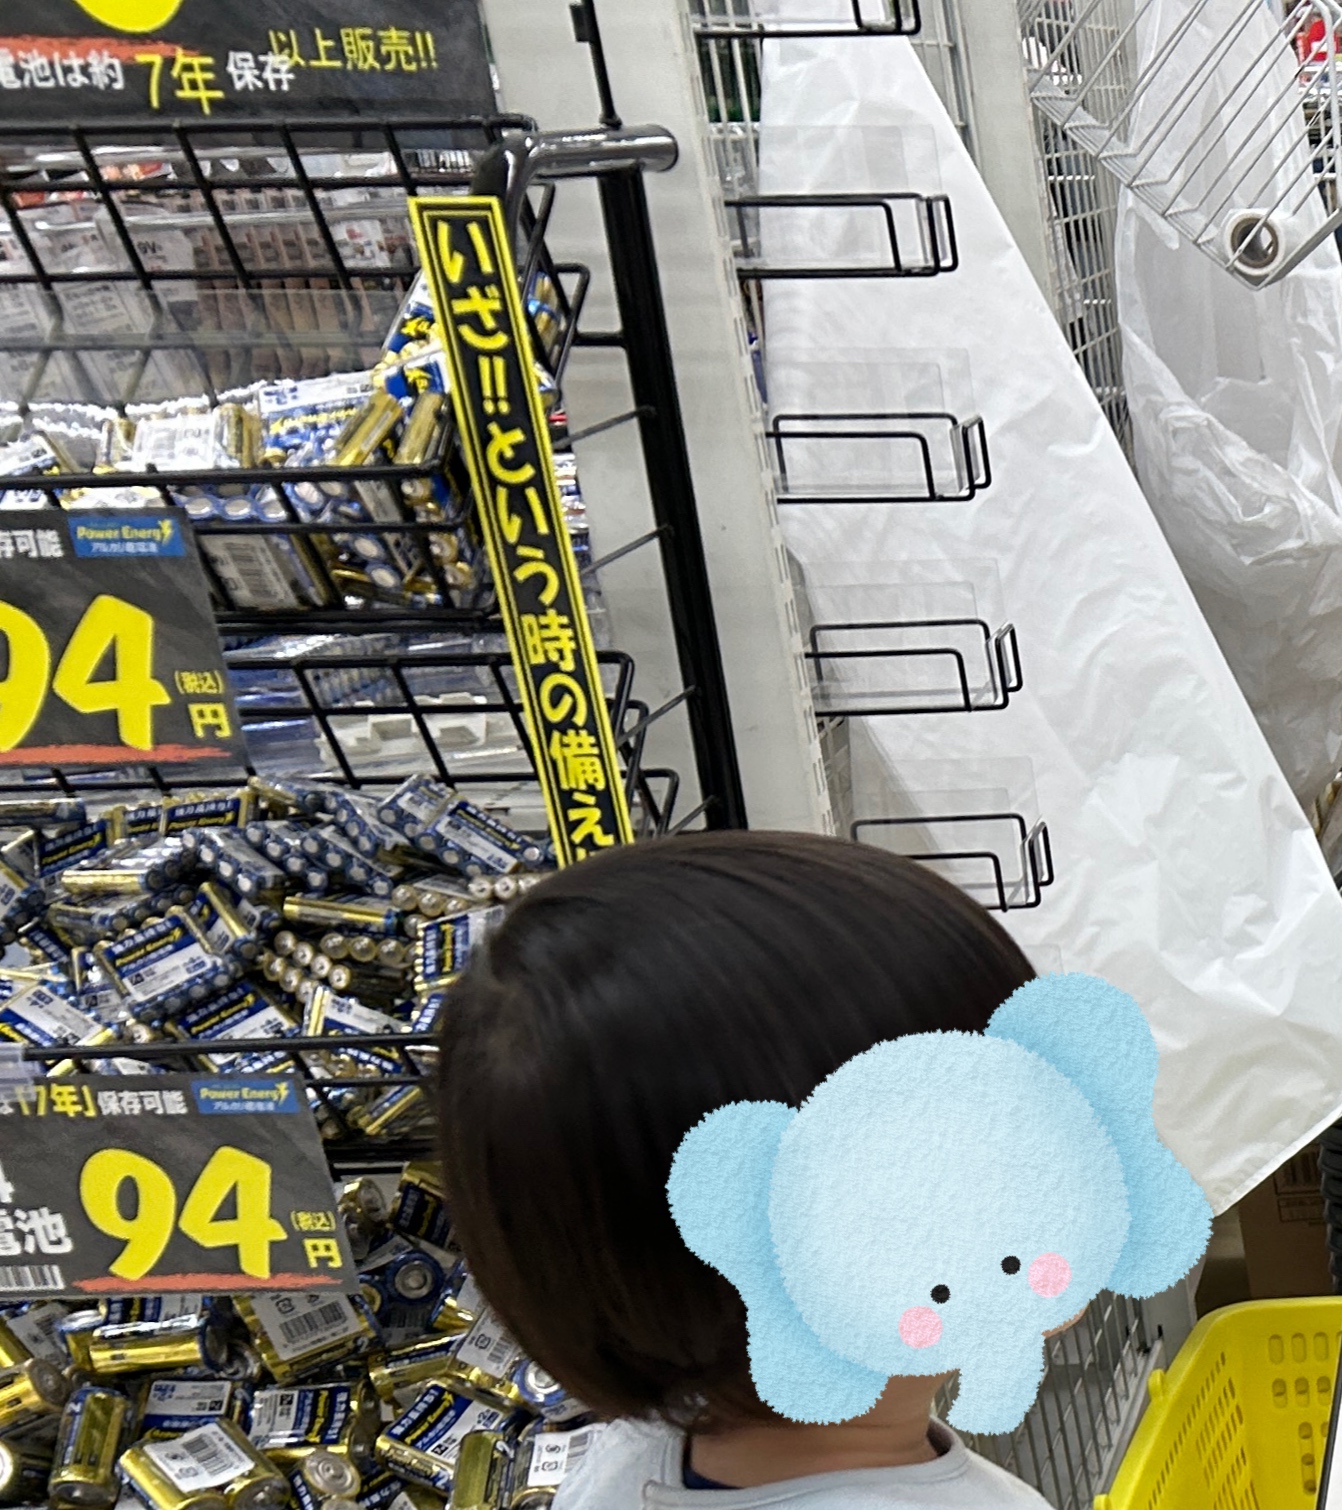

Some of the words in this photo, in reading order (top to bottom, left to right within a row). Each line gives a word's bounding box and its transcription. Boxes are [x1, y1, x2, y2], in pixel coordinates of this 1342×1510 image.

[437, 221, 616, 862] いざ!!という時の備え
[188, 702, 232, 738] 円
[79, 1146, 288, 1281] 94
[303, 1238, 343, 1269] 円
